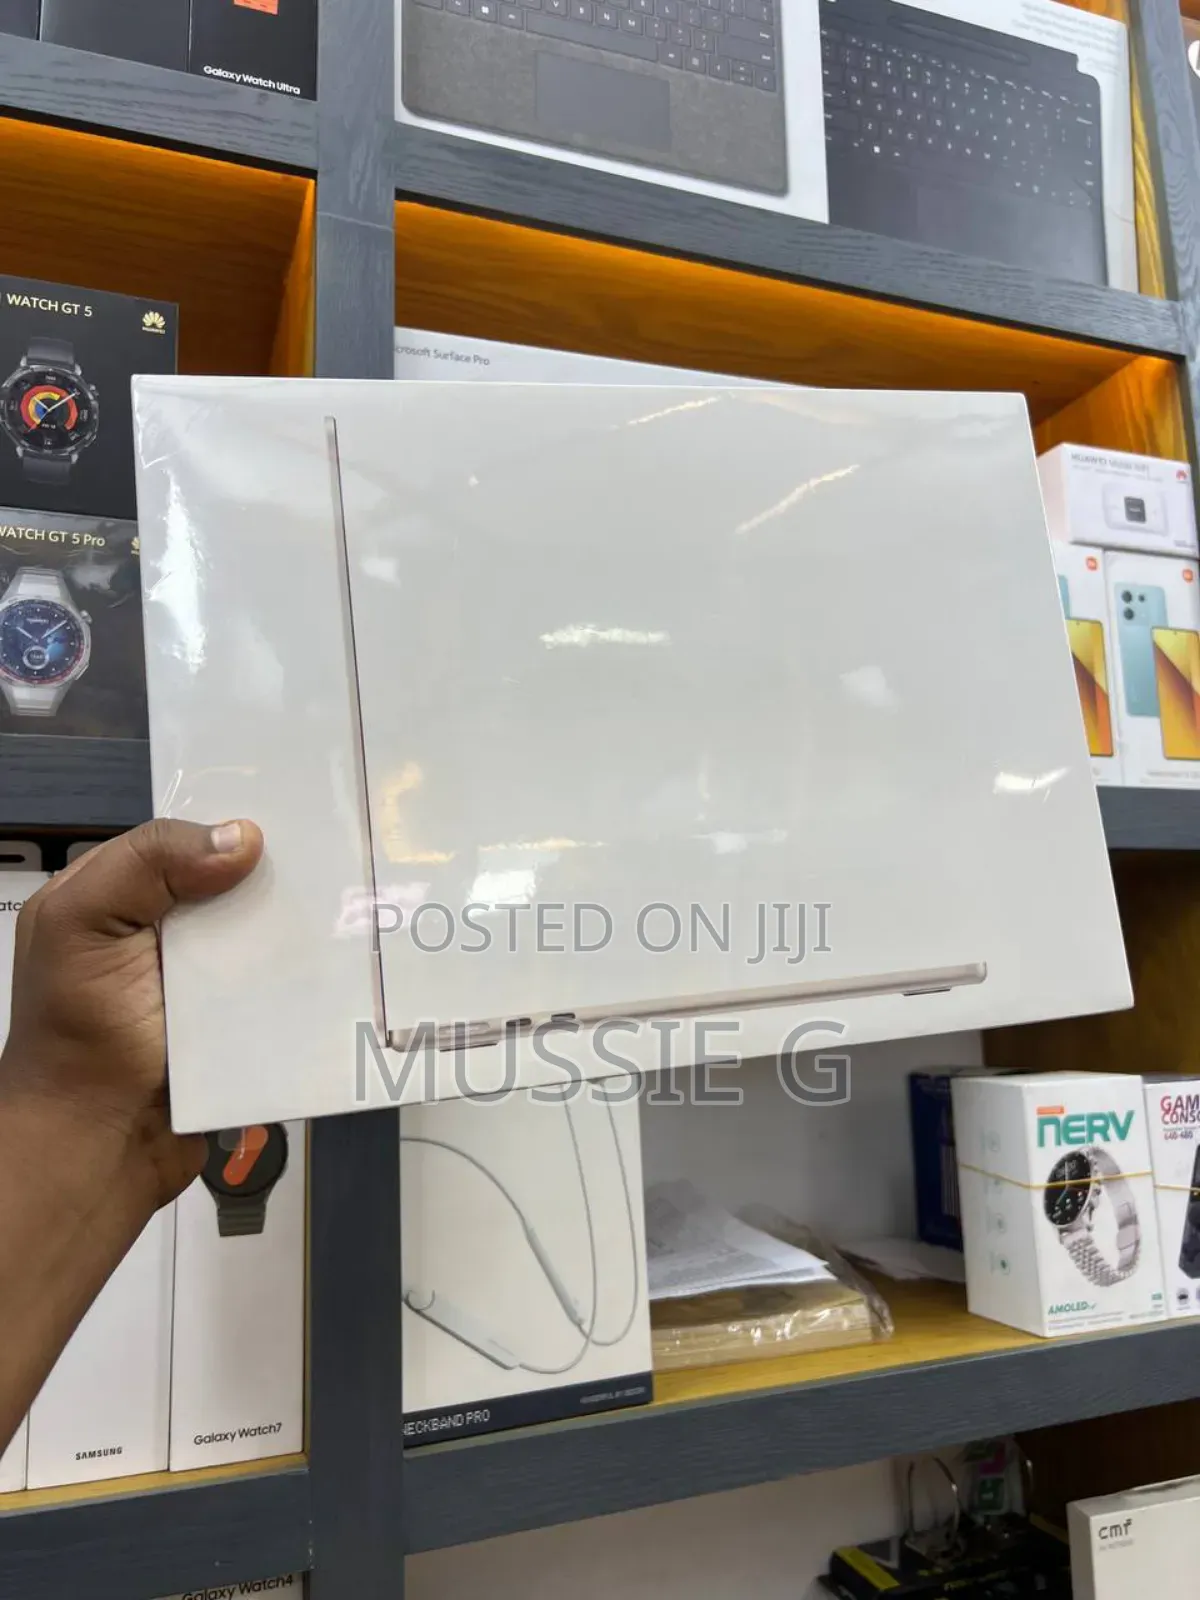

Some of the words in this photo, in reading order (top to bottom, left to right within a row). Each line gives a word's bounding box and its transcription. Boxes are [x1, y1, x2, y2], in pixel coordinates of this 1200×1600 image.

[203, 65, 241, 82] Galaxy
[242, 73, 276, 90] Watch
[276, 81, 301, 95] Ultra
[6, 292, 59, 312] WATCH
[61, 301, 81, 316] GT
[84, 305, 93, 318] 5
[433, 348, 471, 363] Surface
[473, 353, 490, 366] Pro
[48, 530, 68, 543] GT
[71, 533, 80, 545] 5
[83, 534, 106, 547] Pro
[0, 900, 26, 911] atc
[1048, 1301, 1089, 1315] AMOLED
[466, 1408, 491, 1425] PRO
[193, 1430, 237, 1446] Galaxy
[237, 1422, 283, 1438] Watch7
[75, 1446, 123, 1460] SAMSUNG
[1098, 1518, 1133, 1539] cmf
[181, 1586, 237, 1600] Galaxy
[238, 1573, 294, 1595] Watch4
